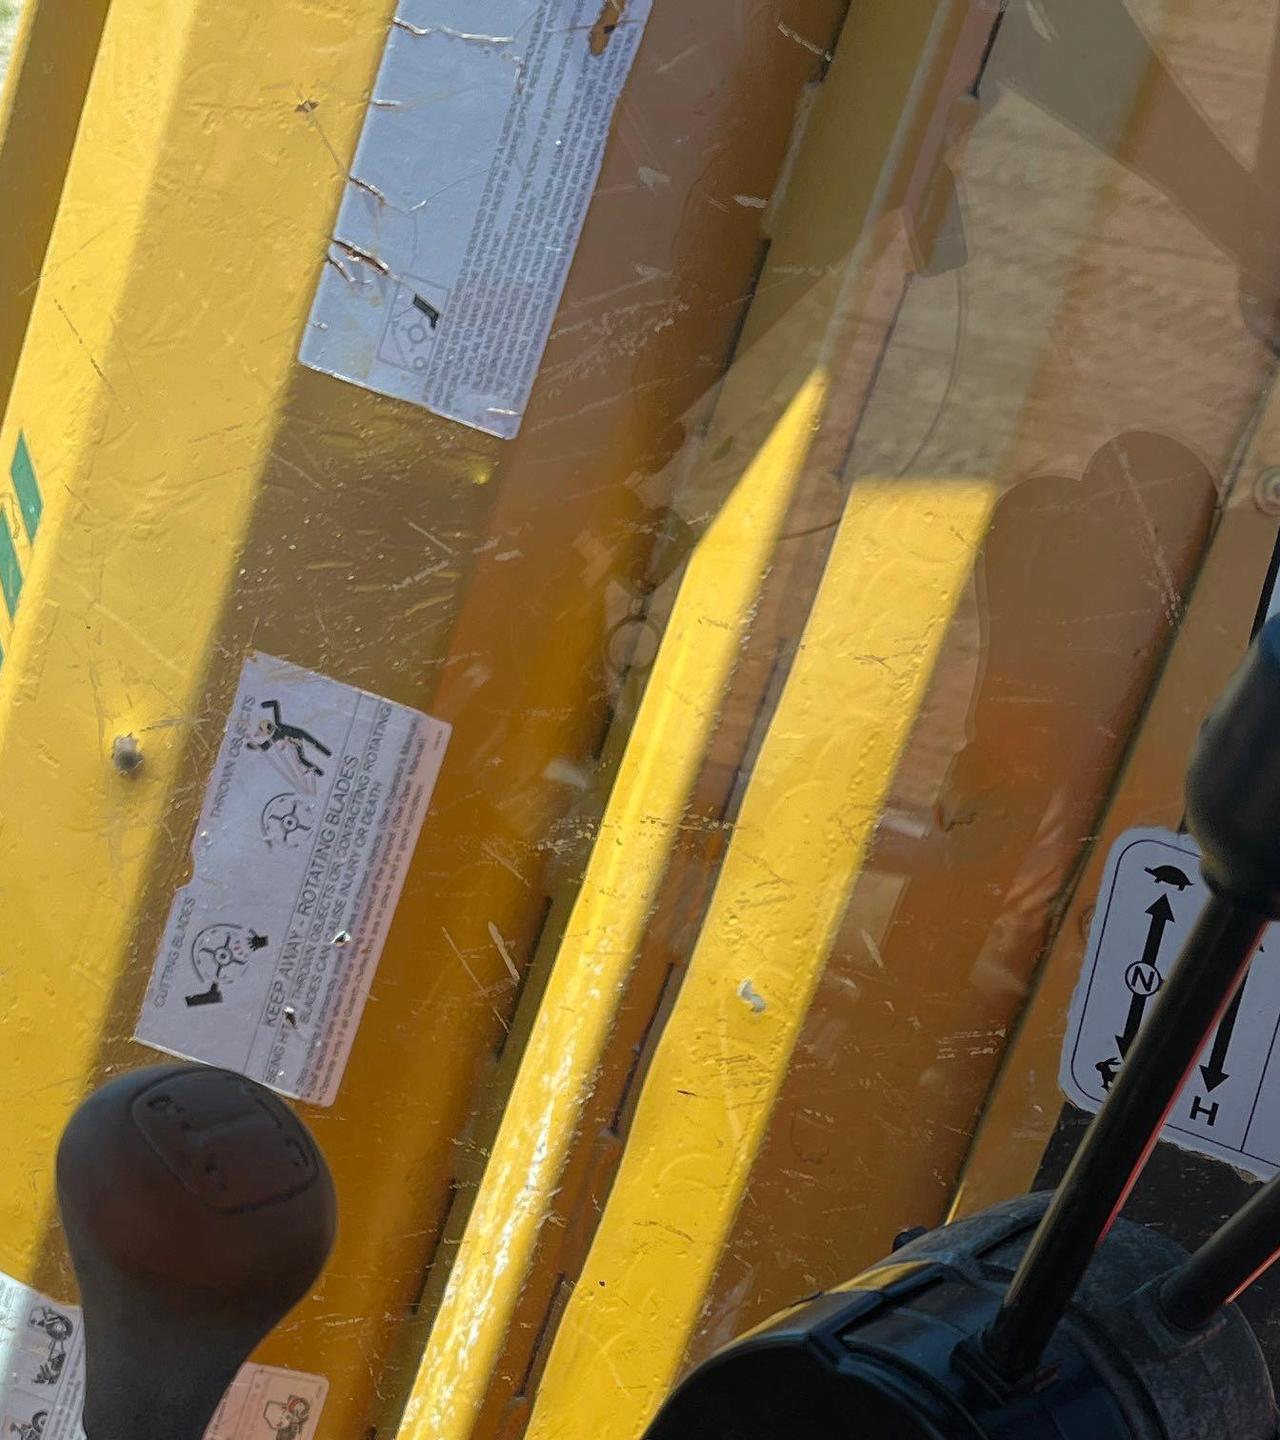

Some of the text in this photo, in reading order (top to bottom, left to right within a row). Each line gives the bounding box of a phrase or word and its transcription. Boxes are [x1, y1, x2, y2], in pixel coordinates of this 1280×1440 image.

[261, 980, 288, 1028] KEEP
[277, 928, 305, 977] AWAY
[295, 826, 338, 917] ROTATING
[324, 753, 361, 826] BLADES
[1130, 966, 1154, 992] N
[1189, 1095, 1219, 1126] H
